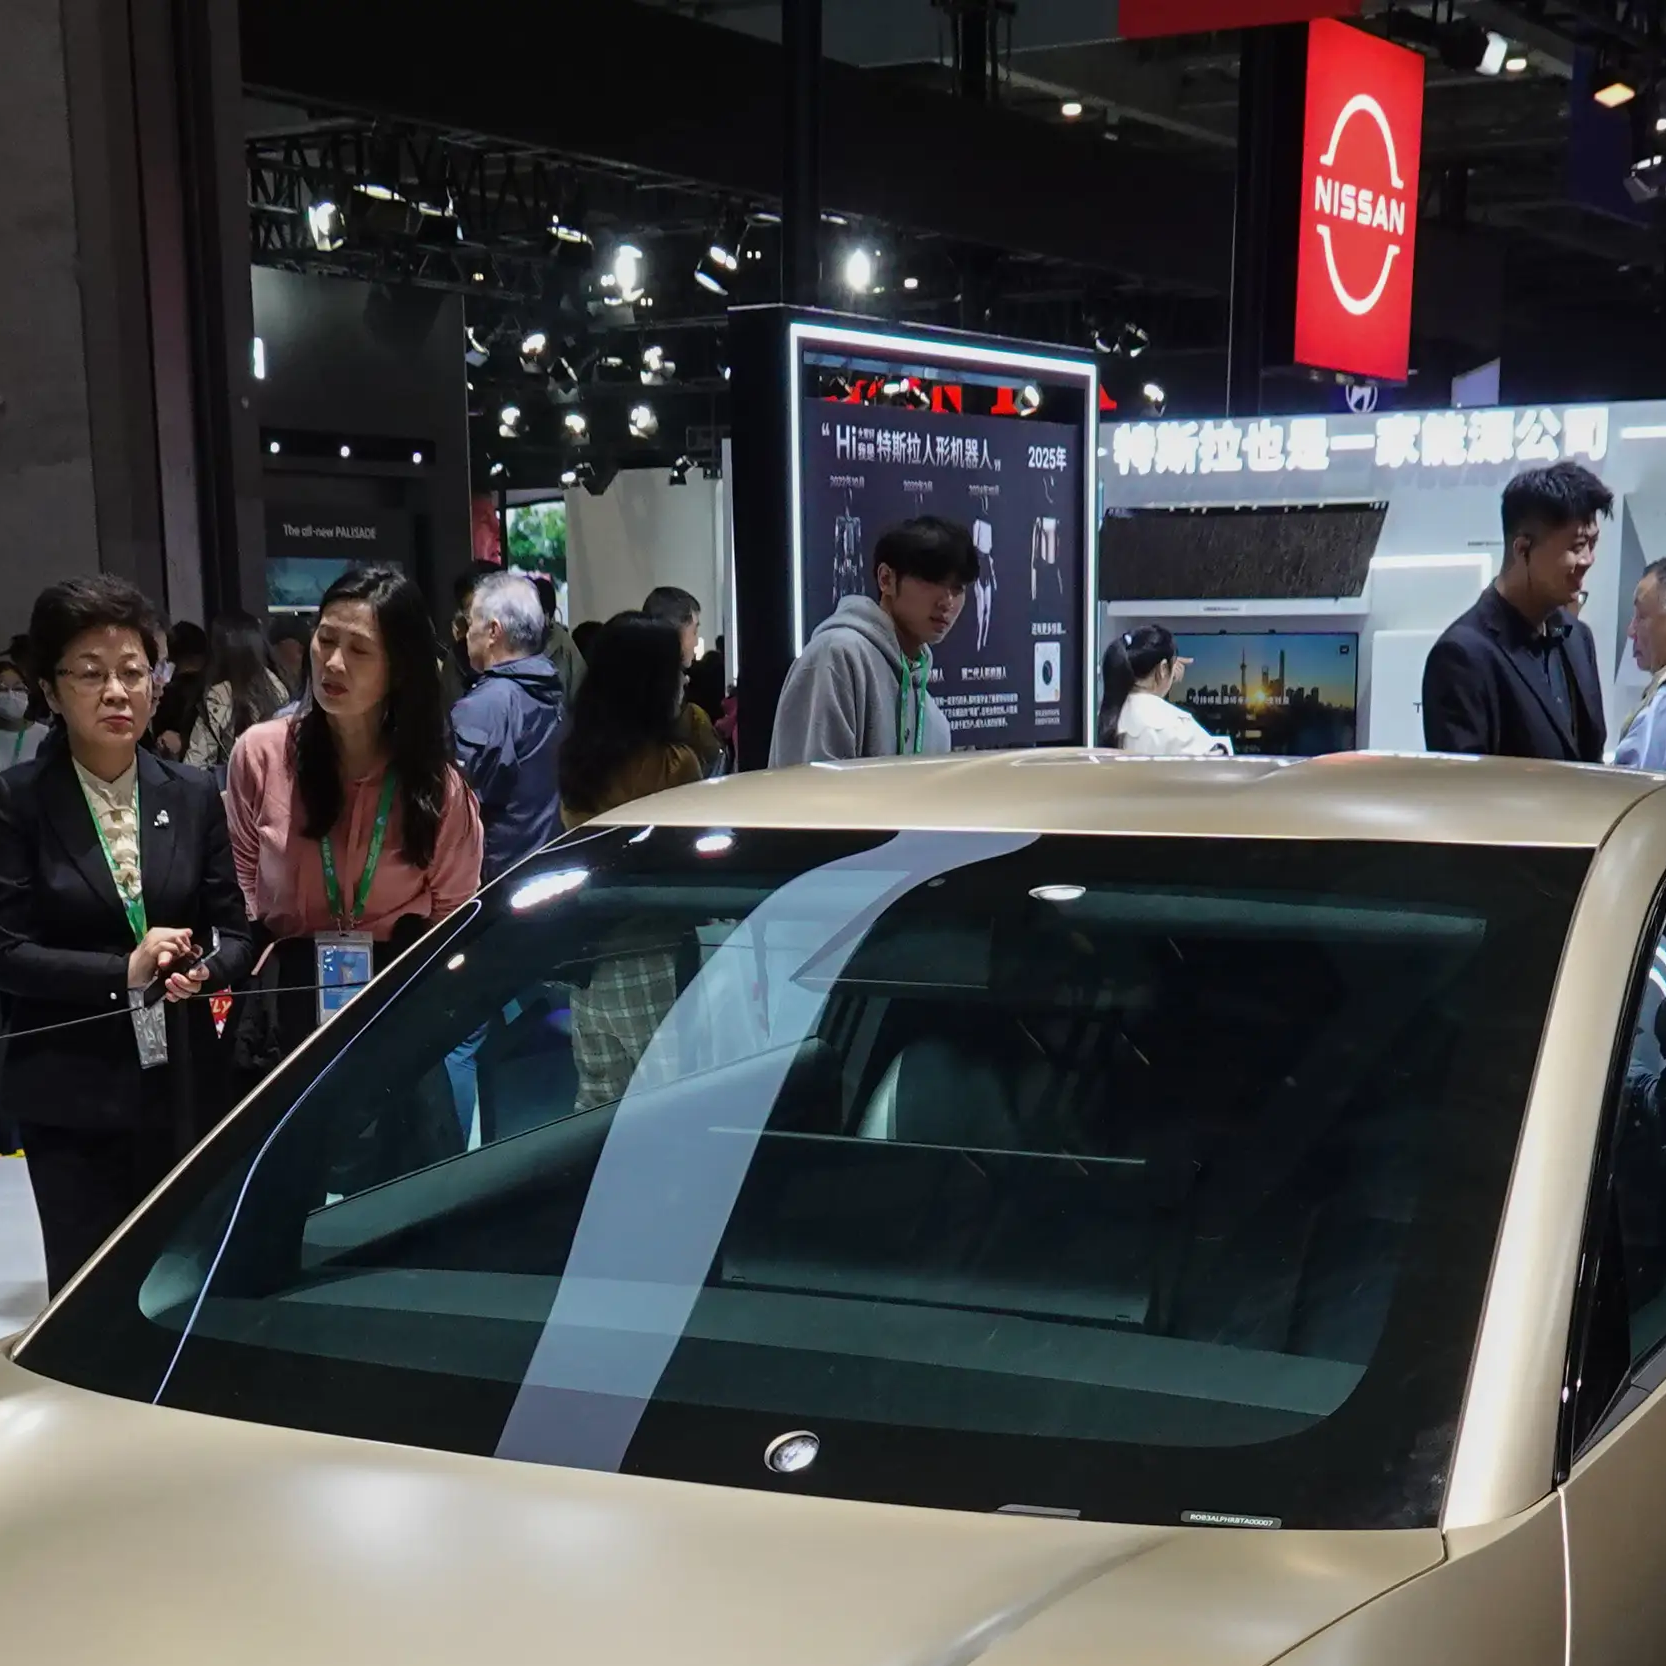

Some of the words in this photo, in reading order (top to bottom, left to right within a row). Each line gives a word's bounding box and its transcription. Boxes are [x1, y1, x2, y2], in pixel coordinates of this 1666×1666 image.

[1314, 175, 1405, 236] NISSAN
[1028, 446, 1067, 471] 2025年
[1113, 406, 1609, 476] 特斯拉也是一家能源公司
